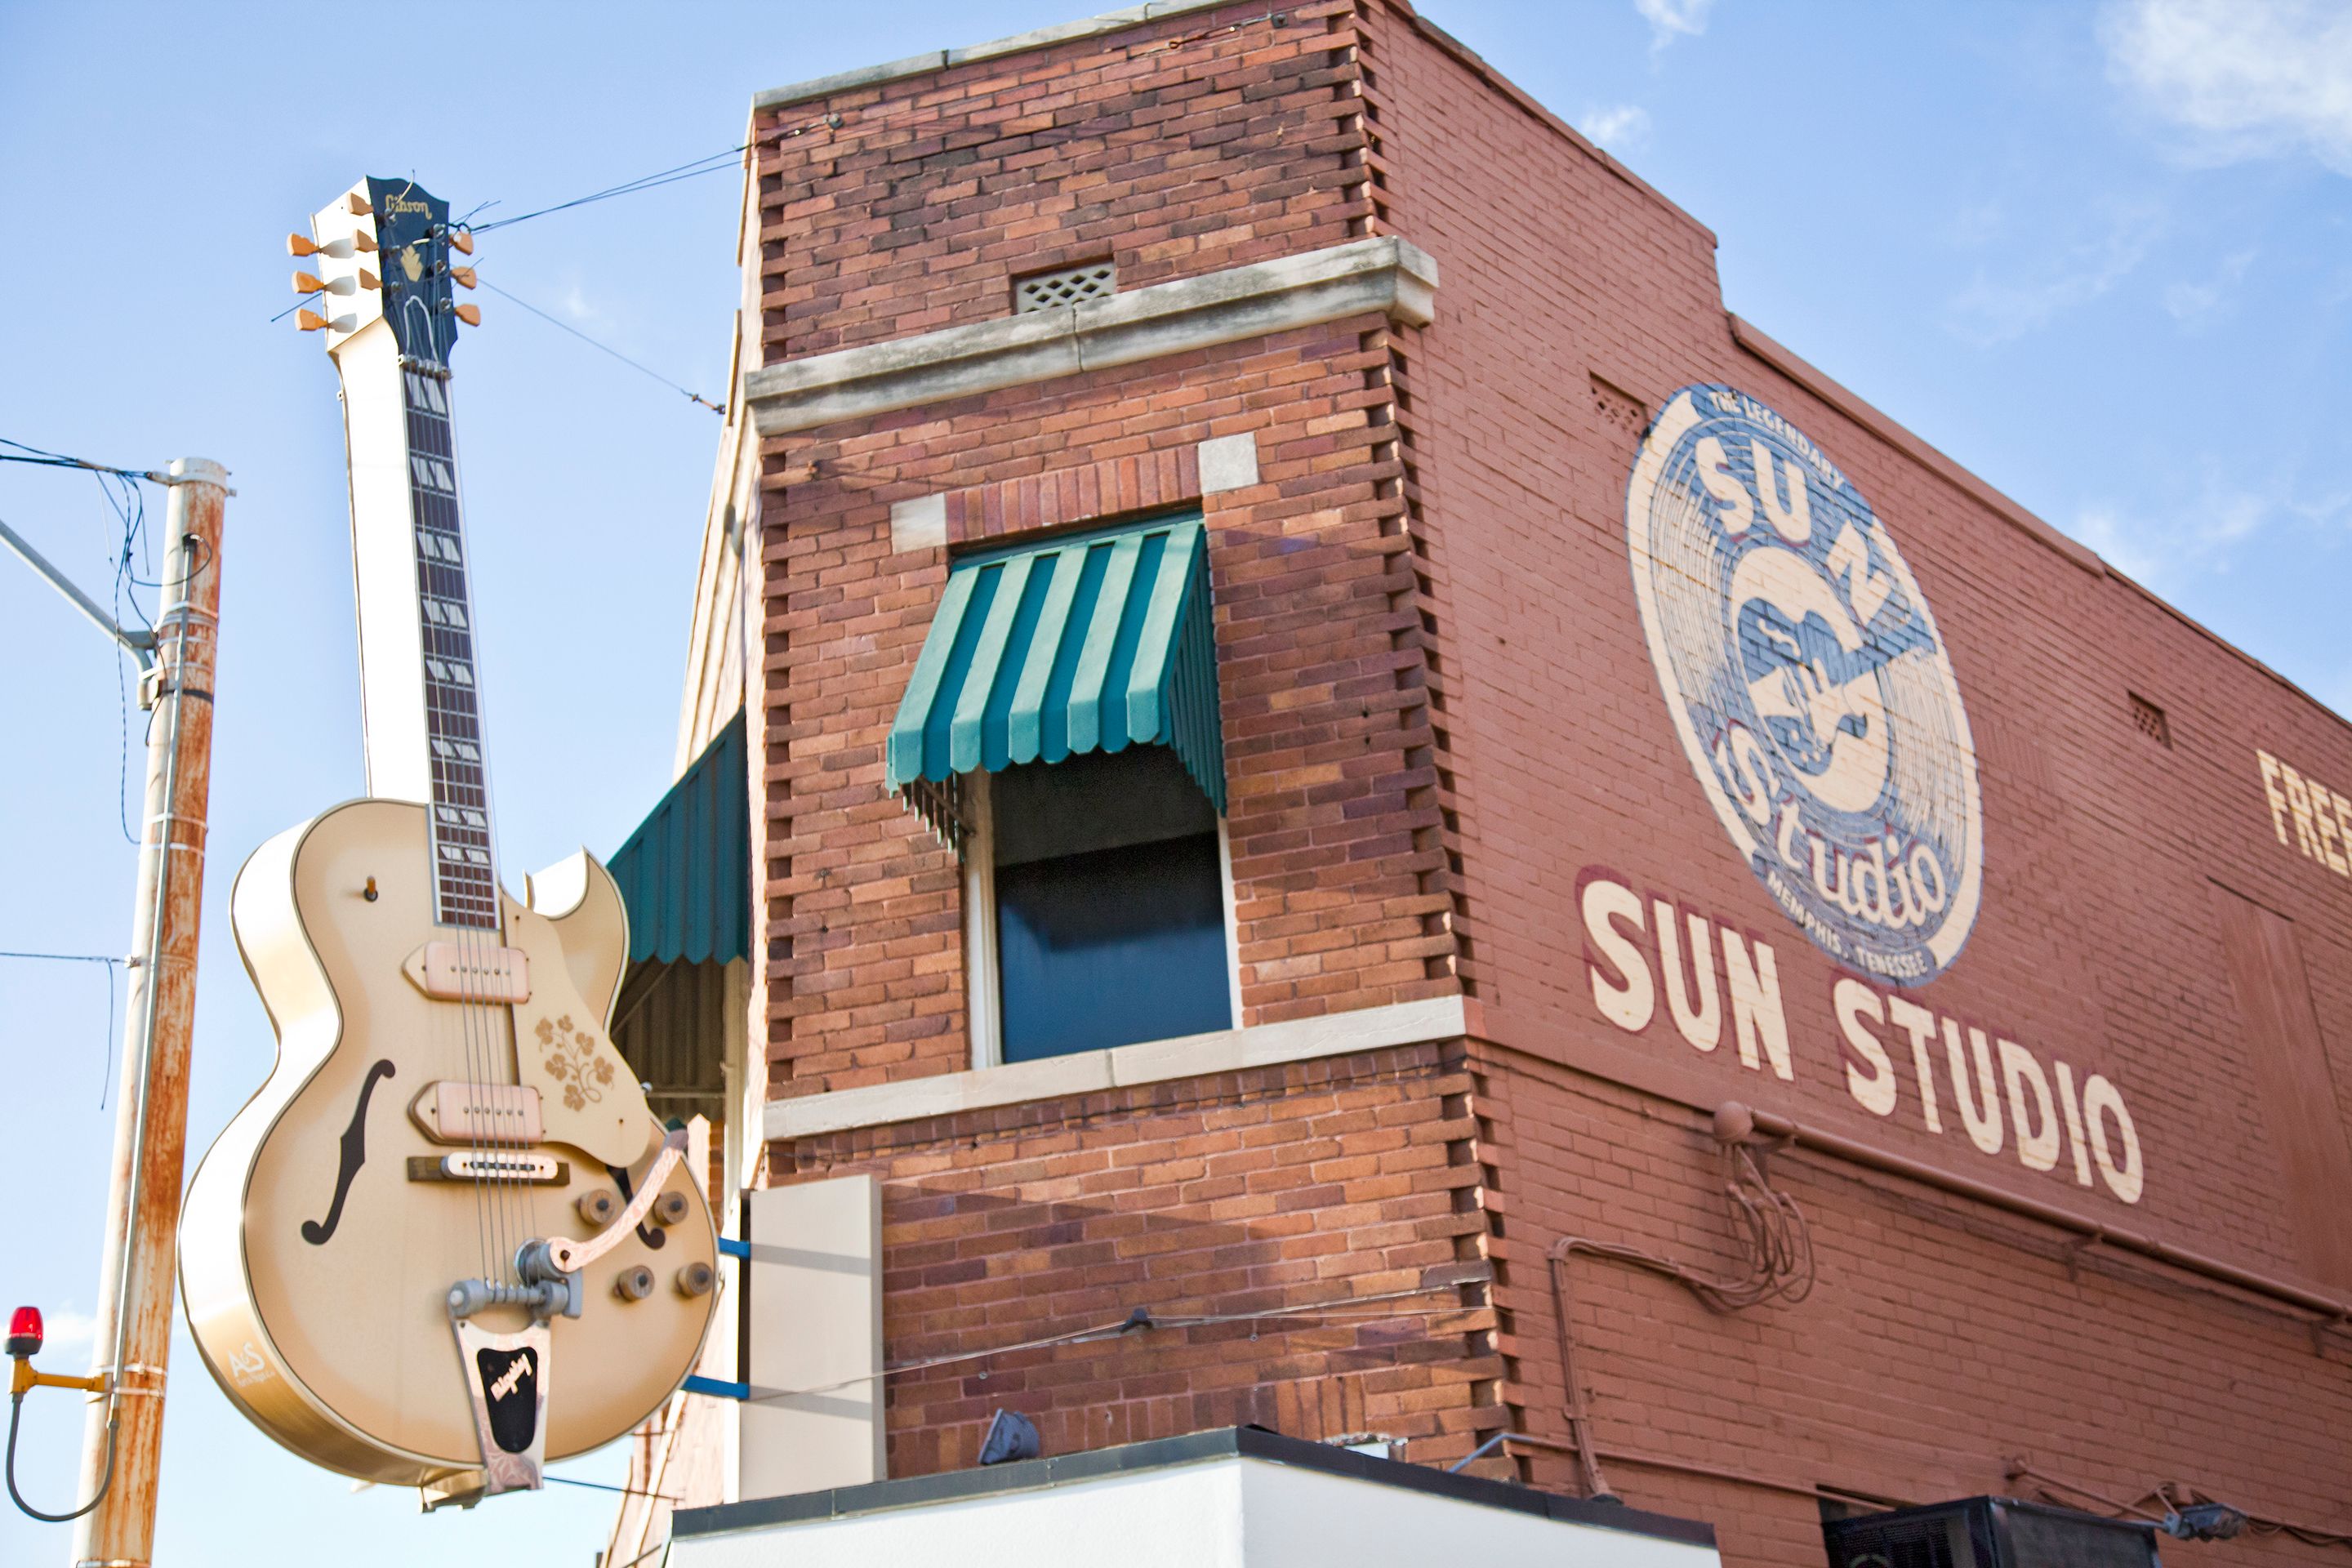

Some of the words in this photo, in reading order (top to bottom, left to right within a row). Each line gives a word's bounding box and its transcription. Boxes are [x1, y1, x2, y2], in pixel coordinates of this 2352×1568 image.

[385, 194, 432, 220] Gibson
[1708, 391, 1742, 414] THE
[1742, 395, 1844, 489] LEGENDARY
[1695, 436, 1894, 625] SUN
[1715, 725, 1947, 929] Studio
[1766, 871, 1849, 959] MEMPHIS,
[1581, 879, 1795, 1082] SUN
[1833, 978, 2145, 1205] STUDIO
